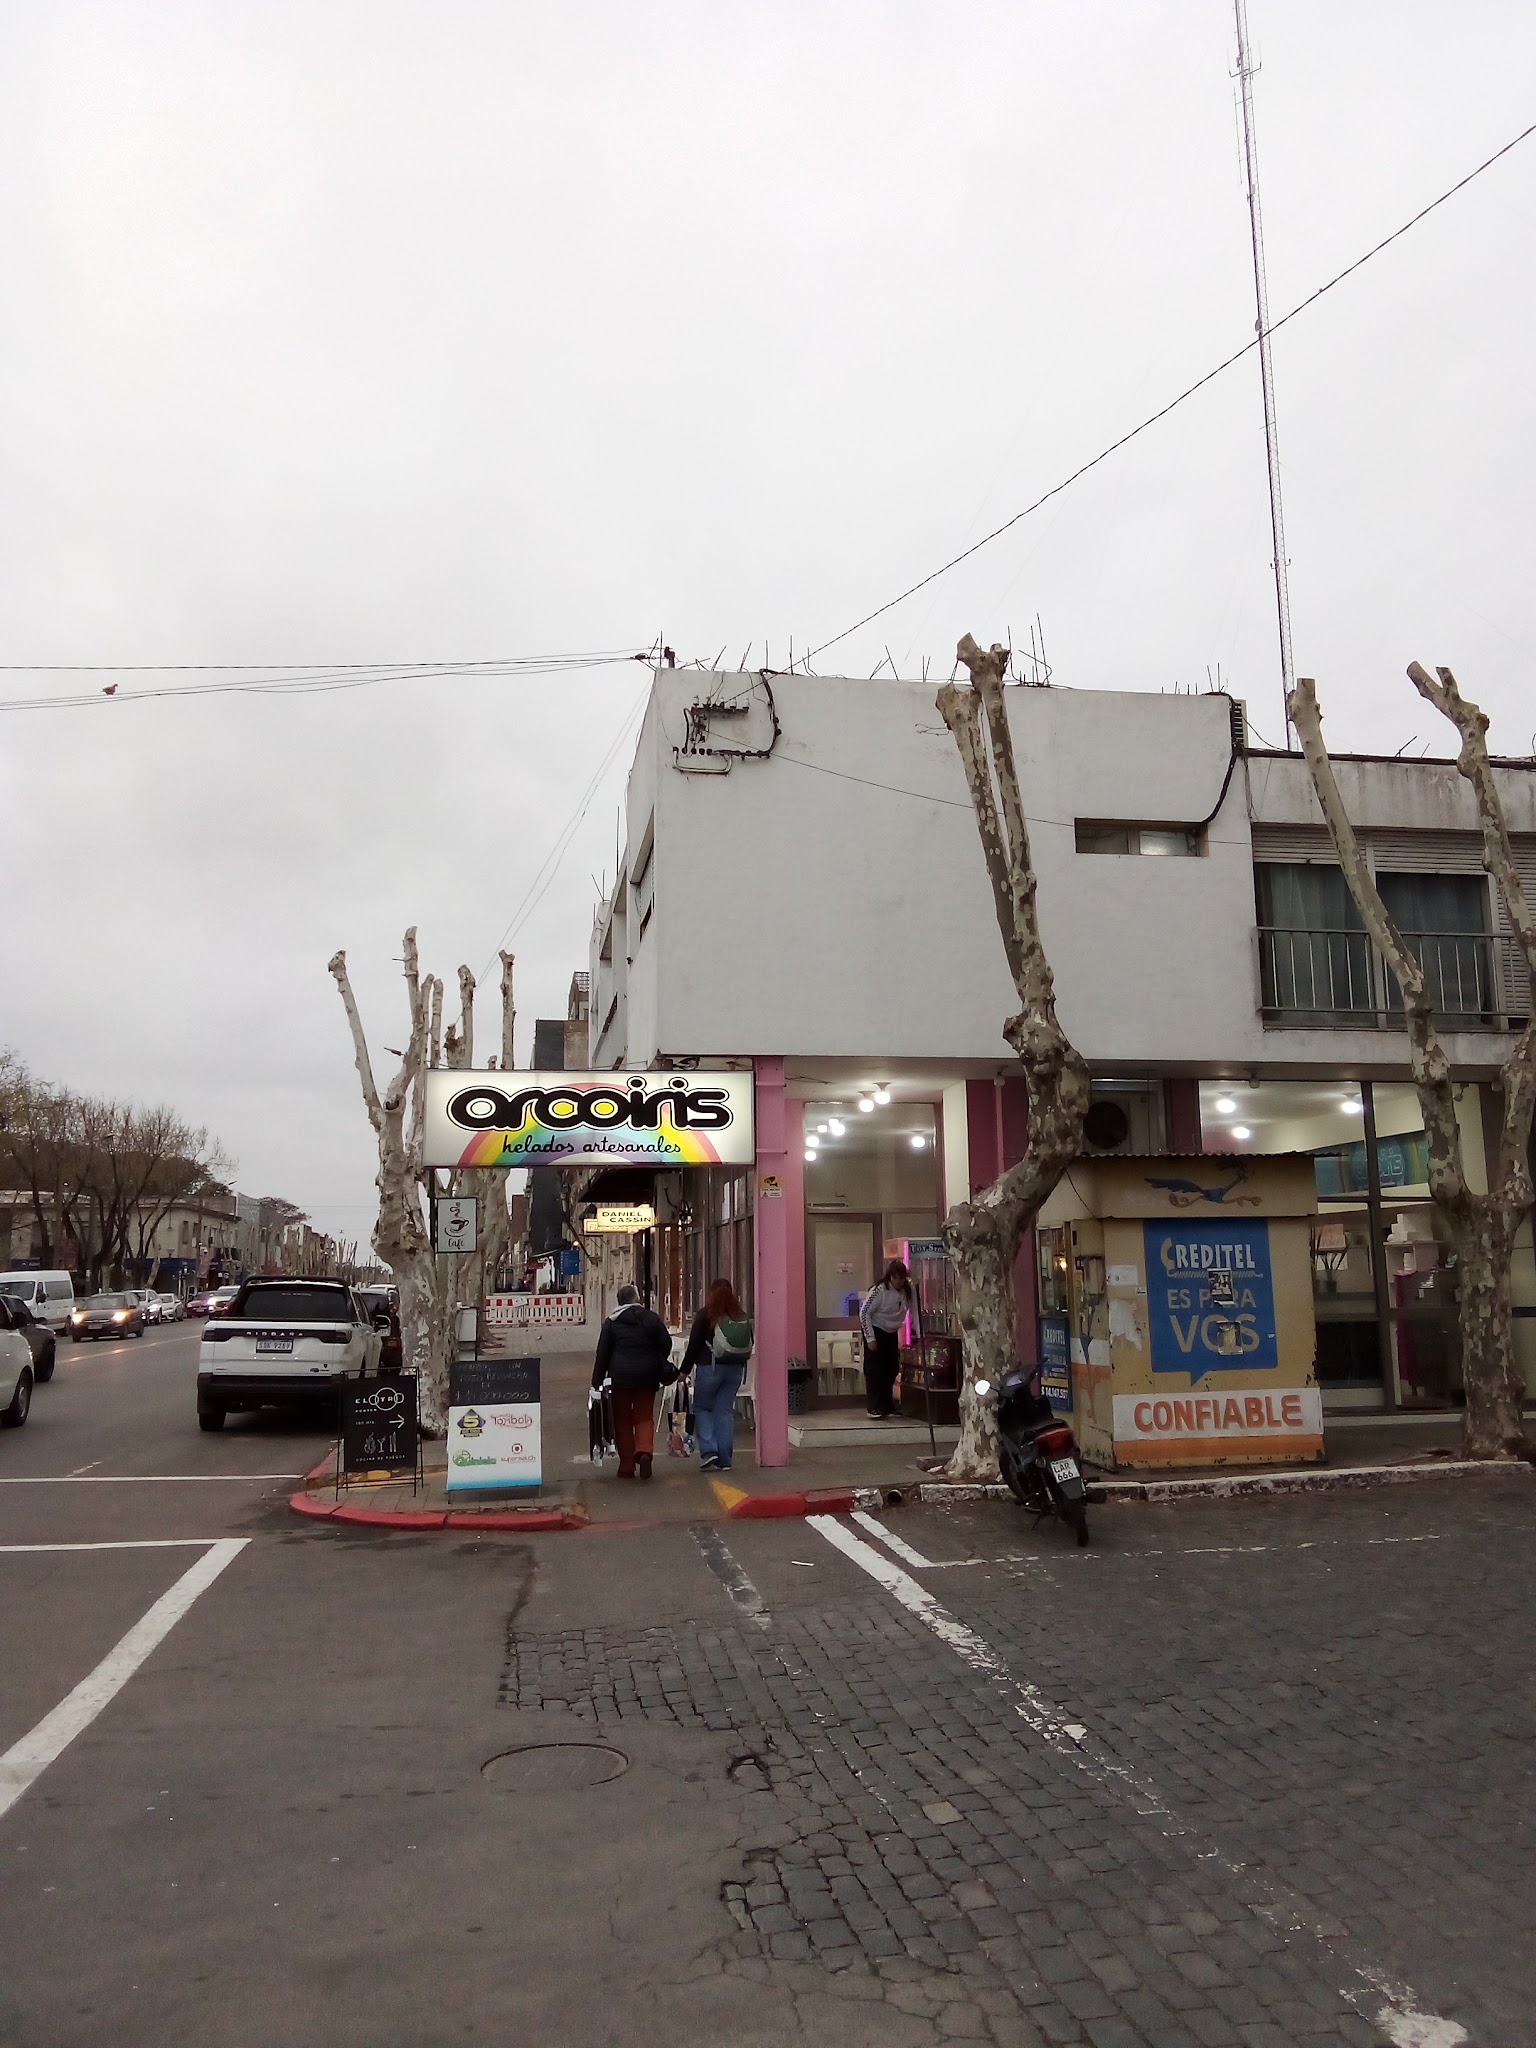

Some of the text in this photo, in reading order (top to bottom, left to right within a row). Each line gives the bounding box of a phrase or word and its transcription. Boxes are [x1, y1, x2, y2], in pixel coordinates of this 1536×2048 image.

[448, 1077, 733, 1131] arcoiris
[502, 1135, 681, 1154] helados artesanales
[1160, 1237, 1255, 1271] CREDITEL
[1167, 1288, 1192, 1309] ES
[1169, 1313, 1260, 1353] VOS
[1134, 1394, 1303, 1433] CONFIABLE
[1057, 1471, 1074, 1481] 666
